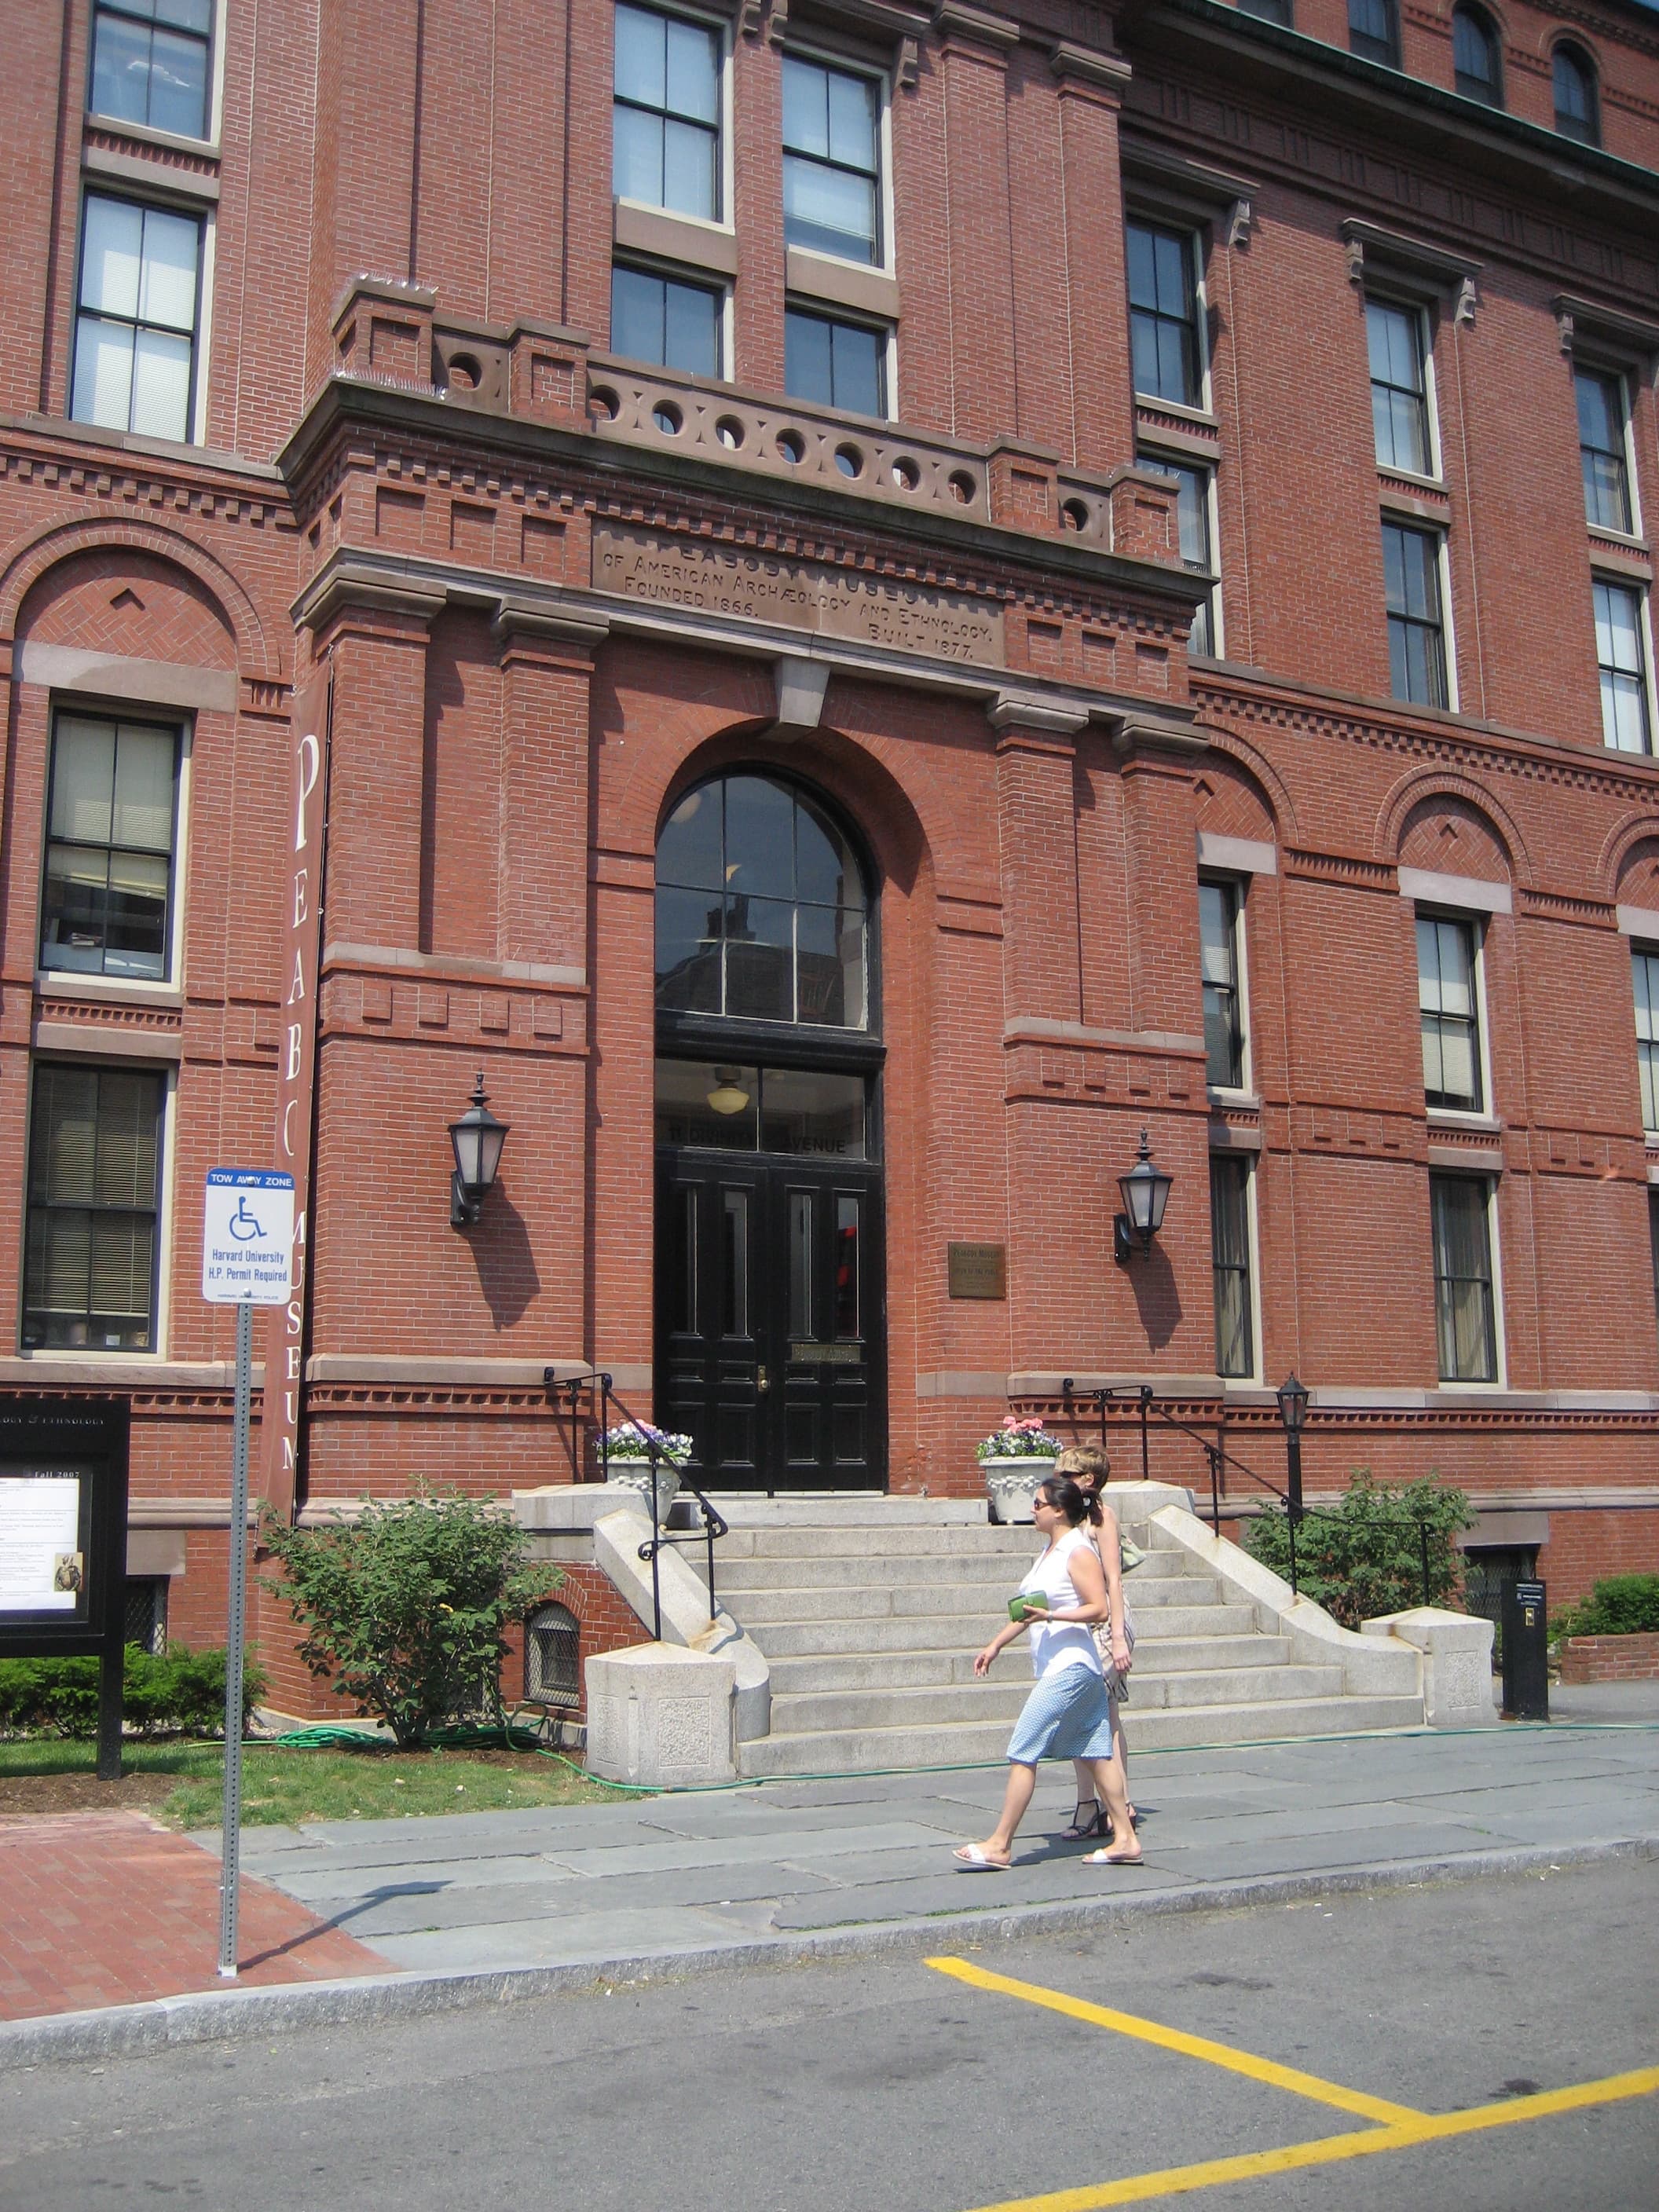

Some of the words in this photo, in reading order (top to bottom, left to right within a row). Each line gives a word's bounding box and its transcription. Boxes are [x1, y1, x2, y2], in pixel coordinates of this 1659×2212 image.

[603, 553, 624, 567] OF
[634, 556, 723, 587] AMERICAN
[860, 603, 890, 621] AND
[624, 576, 705, 606] FOUNDED
[869, 623, 925, 648] BUILT
[211, 1174, 233, 1183] TOW
[265, 1177, 292, 1186] ZONE
[212, 1248, 243, 1262] Harvard
[245, 1250, 284, 1265] University
[226, 1267, 251, 1280] Permit
[254, 1268, 287, 1283] Required
